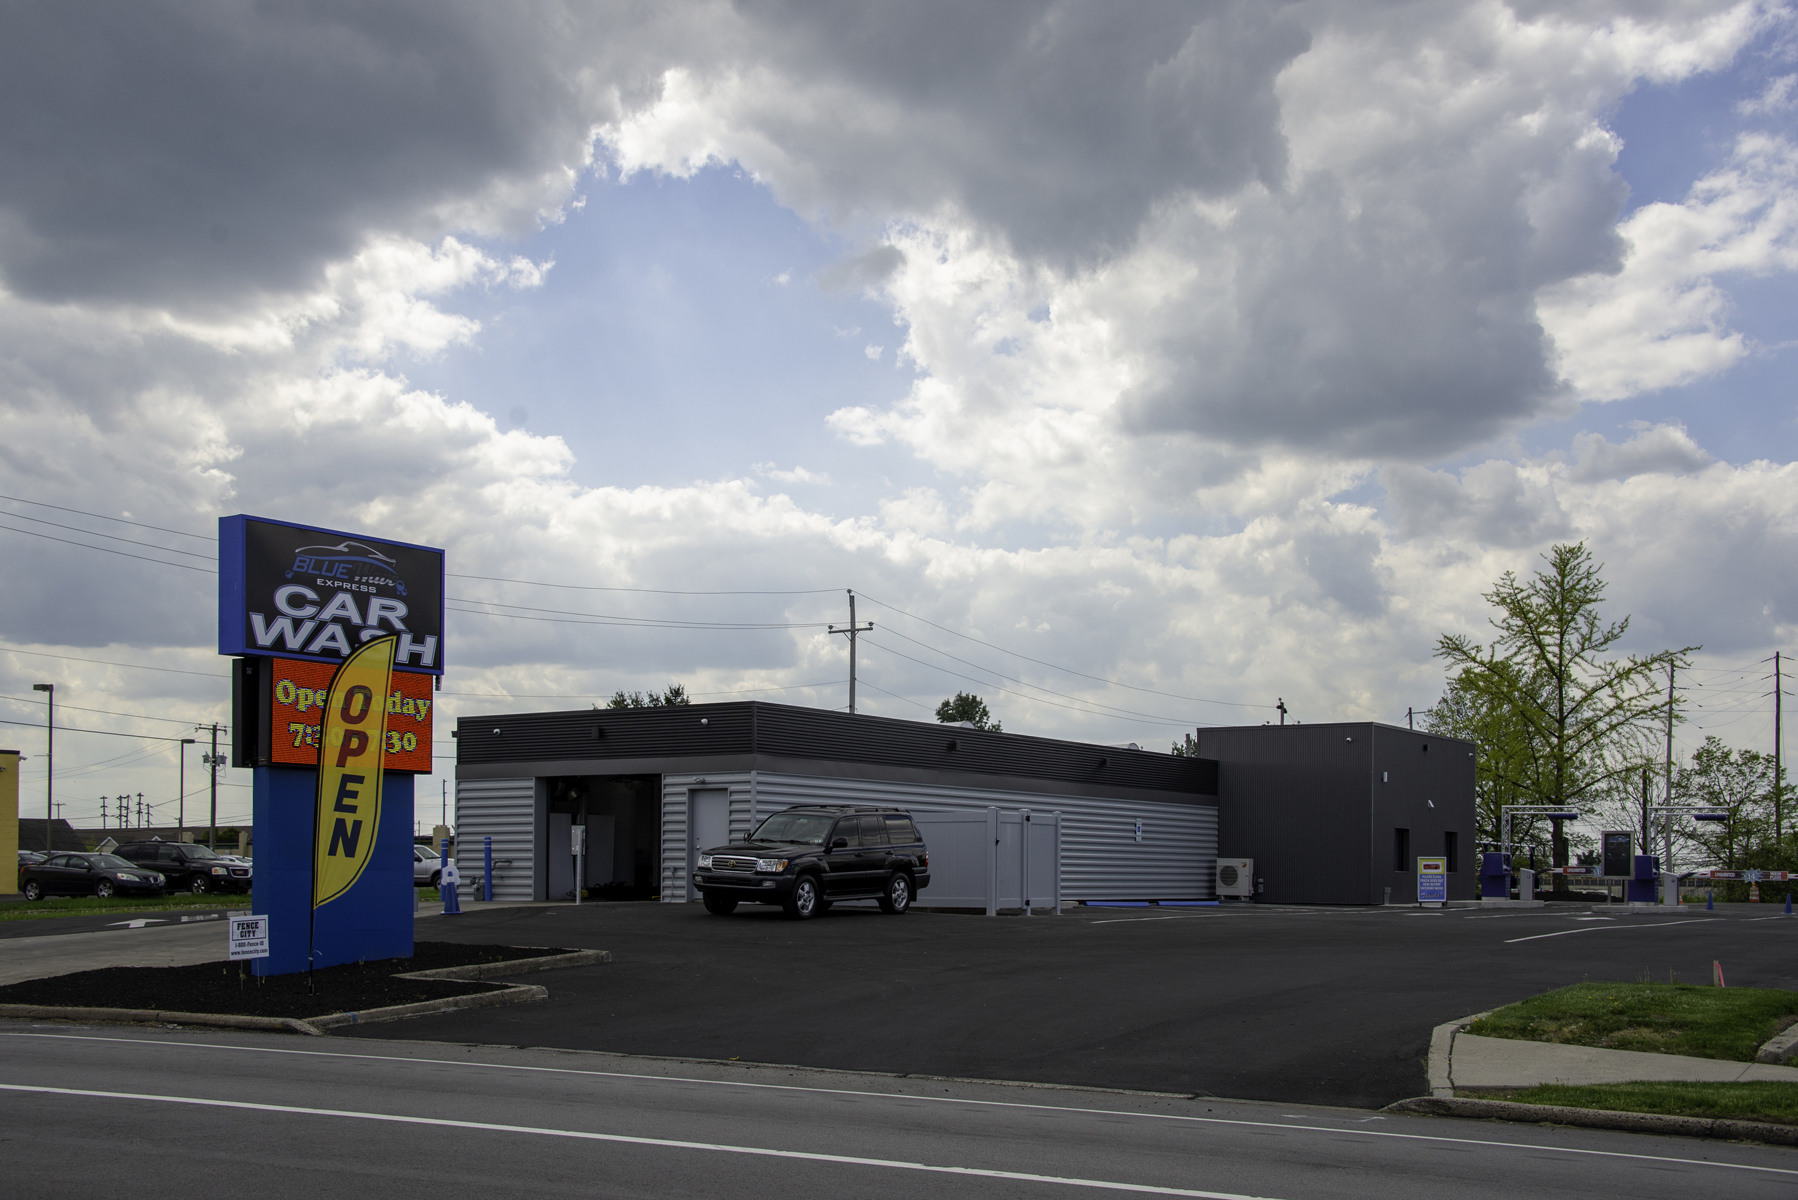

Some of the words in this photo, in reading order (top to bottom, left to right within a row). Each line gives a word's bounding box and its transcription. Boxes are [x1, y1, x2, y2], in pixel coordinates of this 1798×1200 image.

[292, 556, 353, 579] BLUE
[316, 578, 377, 594] EXPRESS
[273, 583, 409, 631] CAR
[327, 685, 373, 858] OPEN
[237, 921, 259, 930] FENCE
[240, 930, 256, 938] CITY
